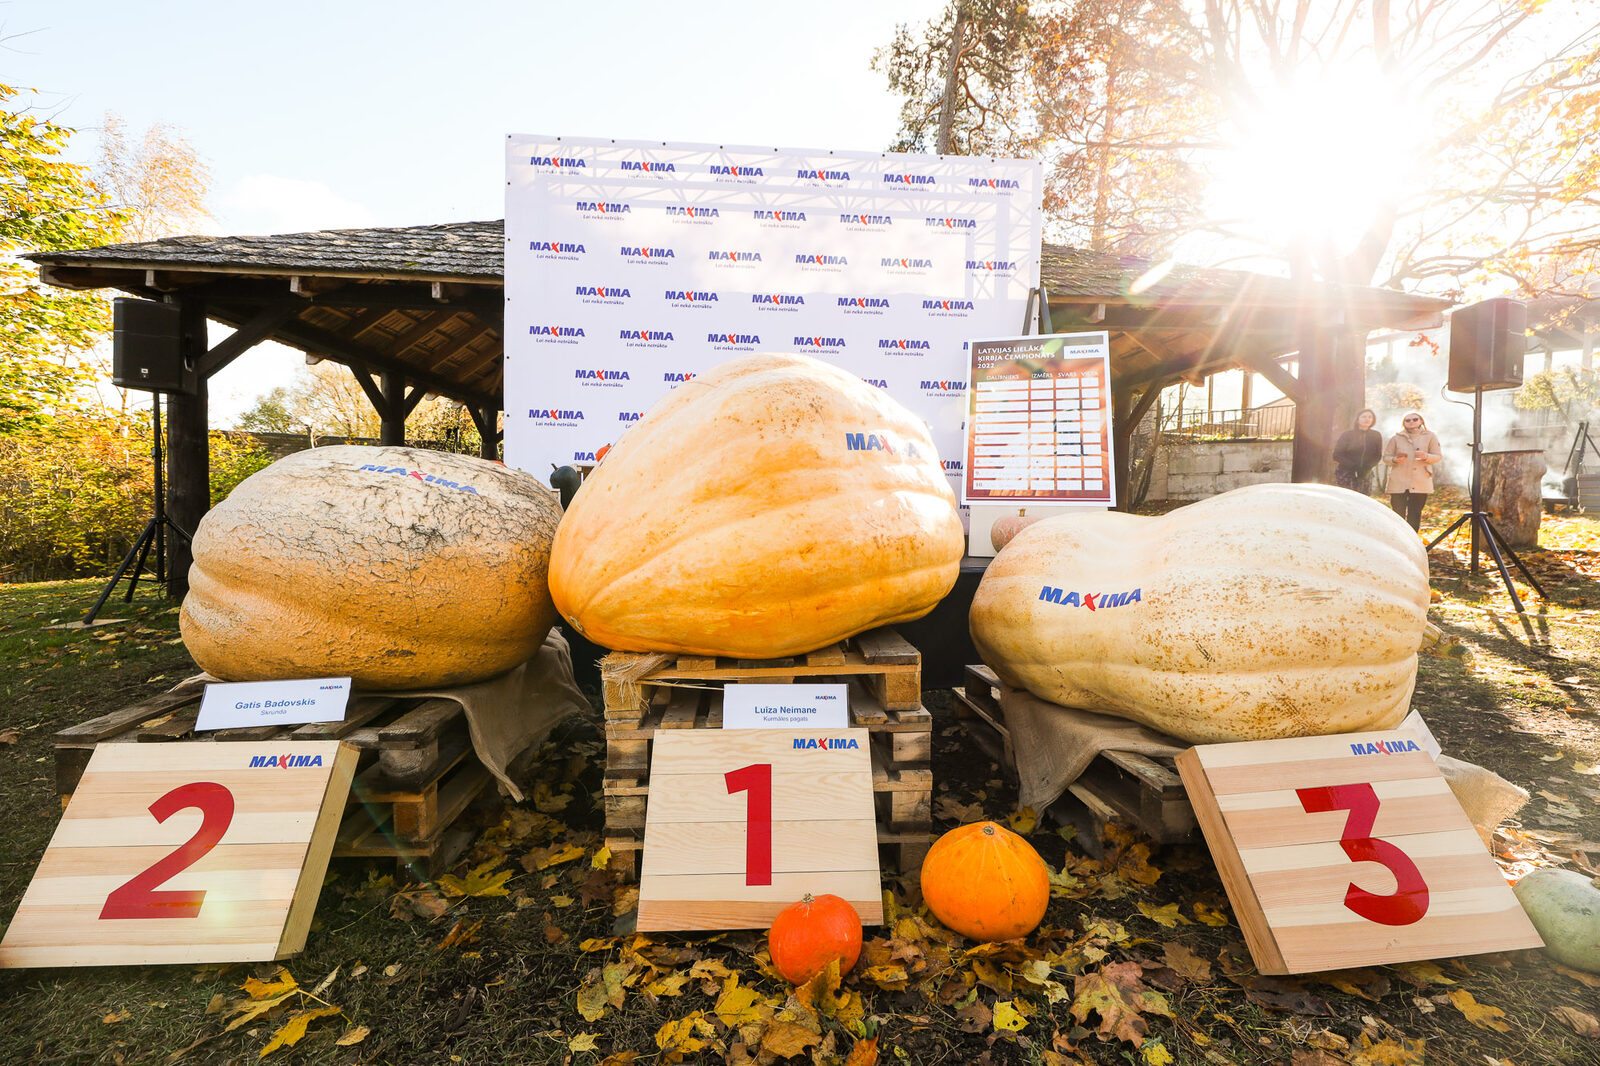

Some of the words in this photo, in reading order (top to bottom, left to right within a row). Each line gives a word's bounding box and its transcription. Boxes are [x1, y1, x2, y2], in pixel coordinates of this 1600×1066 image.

[530, 157, 586, 168] MAXIMA
[621, 161, 675, 172] MAXIMA
[710, 165, 763, 177] MAXIMA
[798, 170, 850, 181] MAXIMA
[884, 174, 936, 185] MAXIMA
[969, 178, 1020, 189] MAXIMA
[576, 202, 631, 213] MAXIMA
[666, 206, 720, 218] MAXIMA
[754, 210, 806, 222] MAXIMA
[840, 214, 892, 226] MAXIMA
[926, 218, 976, 229] MAXIMA
[530, 242, 586, 253] MAXIMA
[620, 246, 674, 258] MAXIMA
[709, 250, 762, 262] MAXIMA
[796, 254, 848, 266] MAXIMA
[881, 258, 932, 269] MAXIMA
[966, 260, 1017, 271] MAXIMA
[576, 286, 630, 298] MAXIMA
[665, 290, 718, 302] MAXIMA
[752, 294, 804, 305] MAXIMA
[838, 298, 890, 308] MAXIMA
[922, 300, 974, 311] MAXIMA
[530, 326, 585, 337] MAXIMA
[620, 330, 674, 341] MAXIMA
[708, 334, 760, 344] MAXIMA
[794, 337, 846, 348] MAXIMA
[879, 340, 930, 350] MAXIMA
[1004, 352, 1055, 360] ČEMPIONĀTS
[575, 370, 630, 380] MAXIMA
[664, 373, 696, 382] MAX
[529, 409, 584, 420] MAXIMA
[940, 460, 963, 470] XIM
[360, 464, 479, 495] MAXIMA
[1038, 586, 1142, 612] MAXIMA
[235, 701, 261, 710] Gatis
[264, 698, 316, 708] Badovskis
[260, 708, 287, 716] Skrunda
[780, 706, 817, 714] Neimane
[792, 737, 859, 750] MAXIMA
[1350, 739, 1421, 756] MAXIMA
[249, 753, 322, 770] MAXIMA
[724, 764, 772, 886] 1
[98, 782, 235, 920] 2
[1295, 782, 1430, 926] 3
